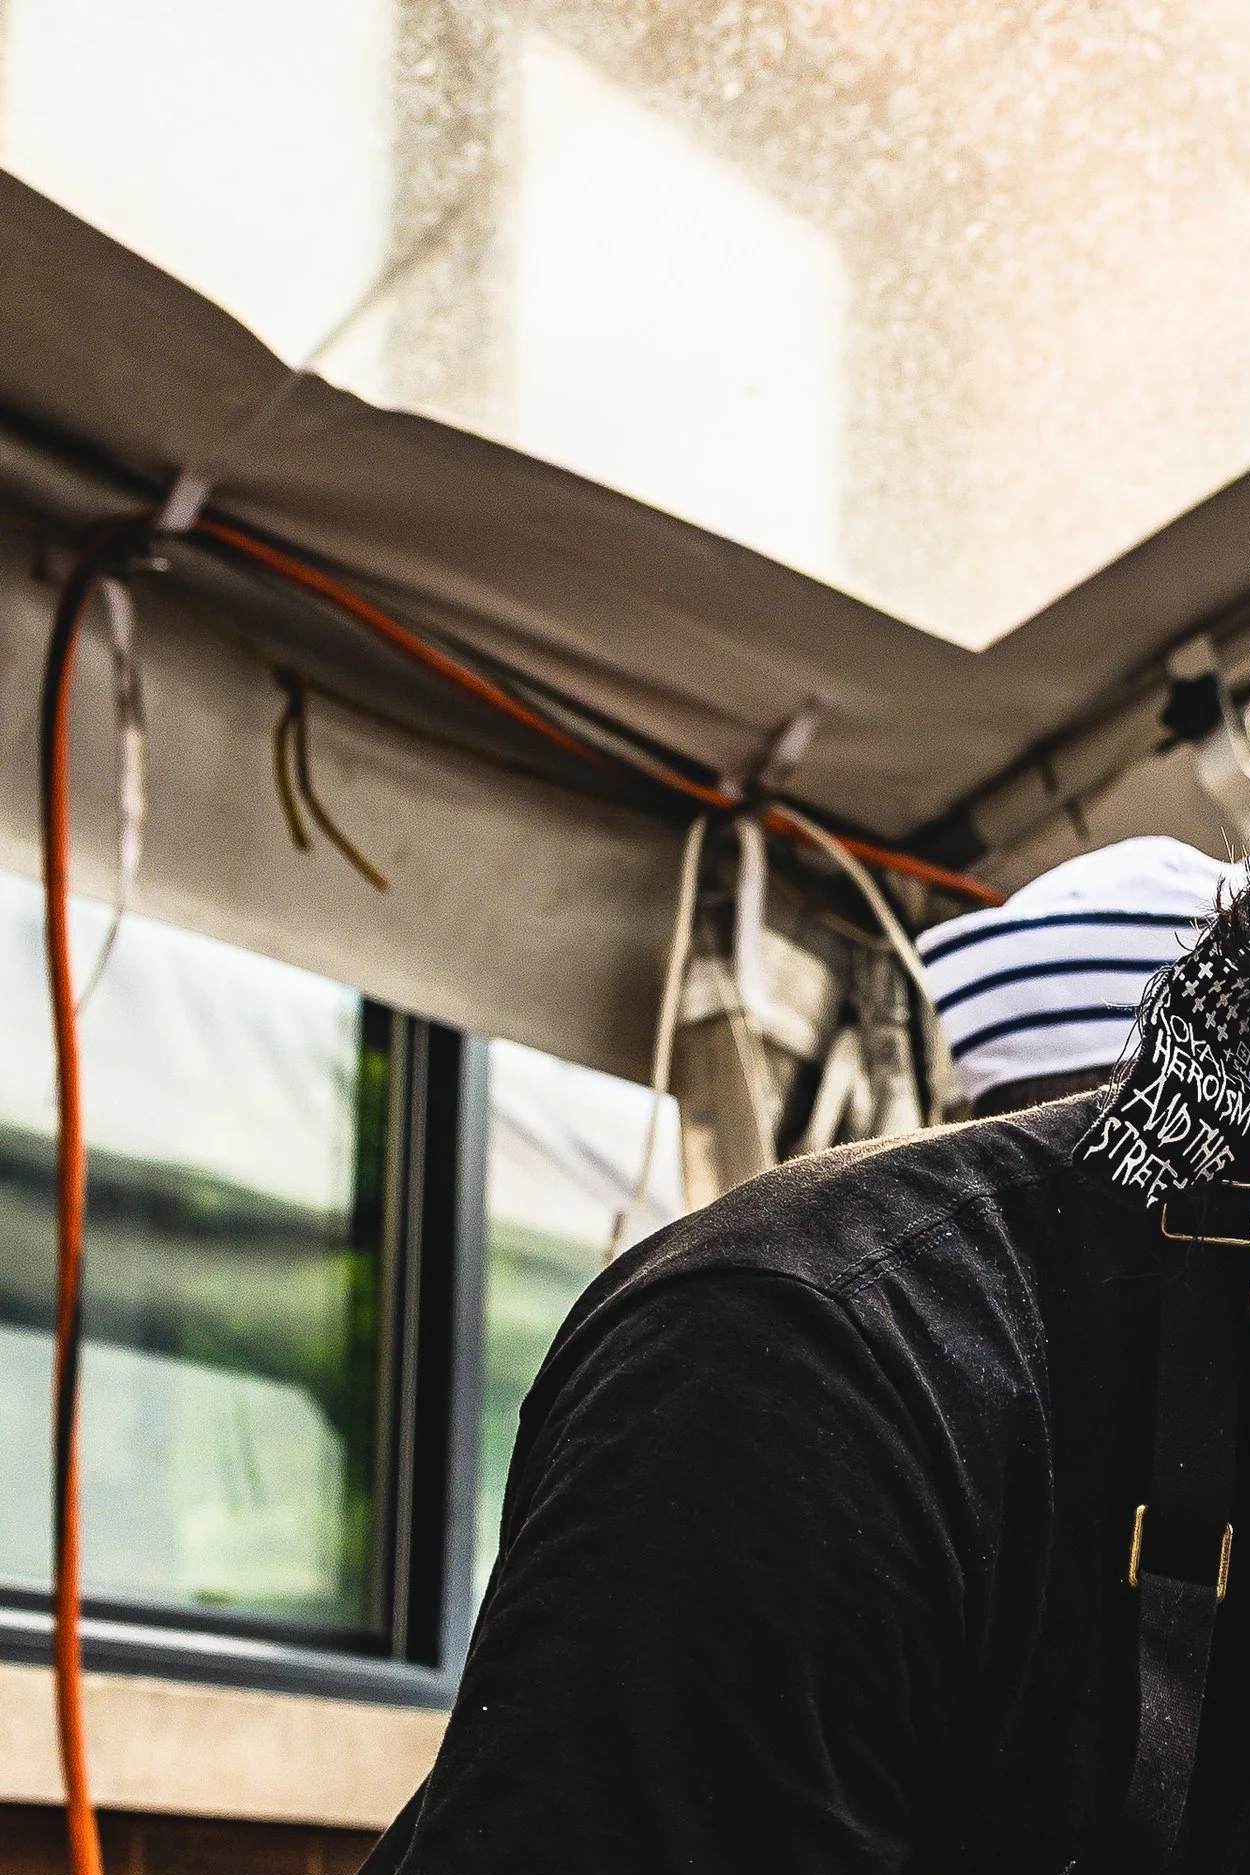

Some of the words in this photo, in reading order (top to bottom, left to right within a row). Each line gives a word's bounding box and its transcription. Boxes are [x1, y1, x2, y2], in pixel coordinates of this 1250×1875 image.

[1083, 1117, 1187, 1208] STREE
[1121, 1075, 1191, 1148] AND
[1182, 1118, 1235, 1186] THE
